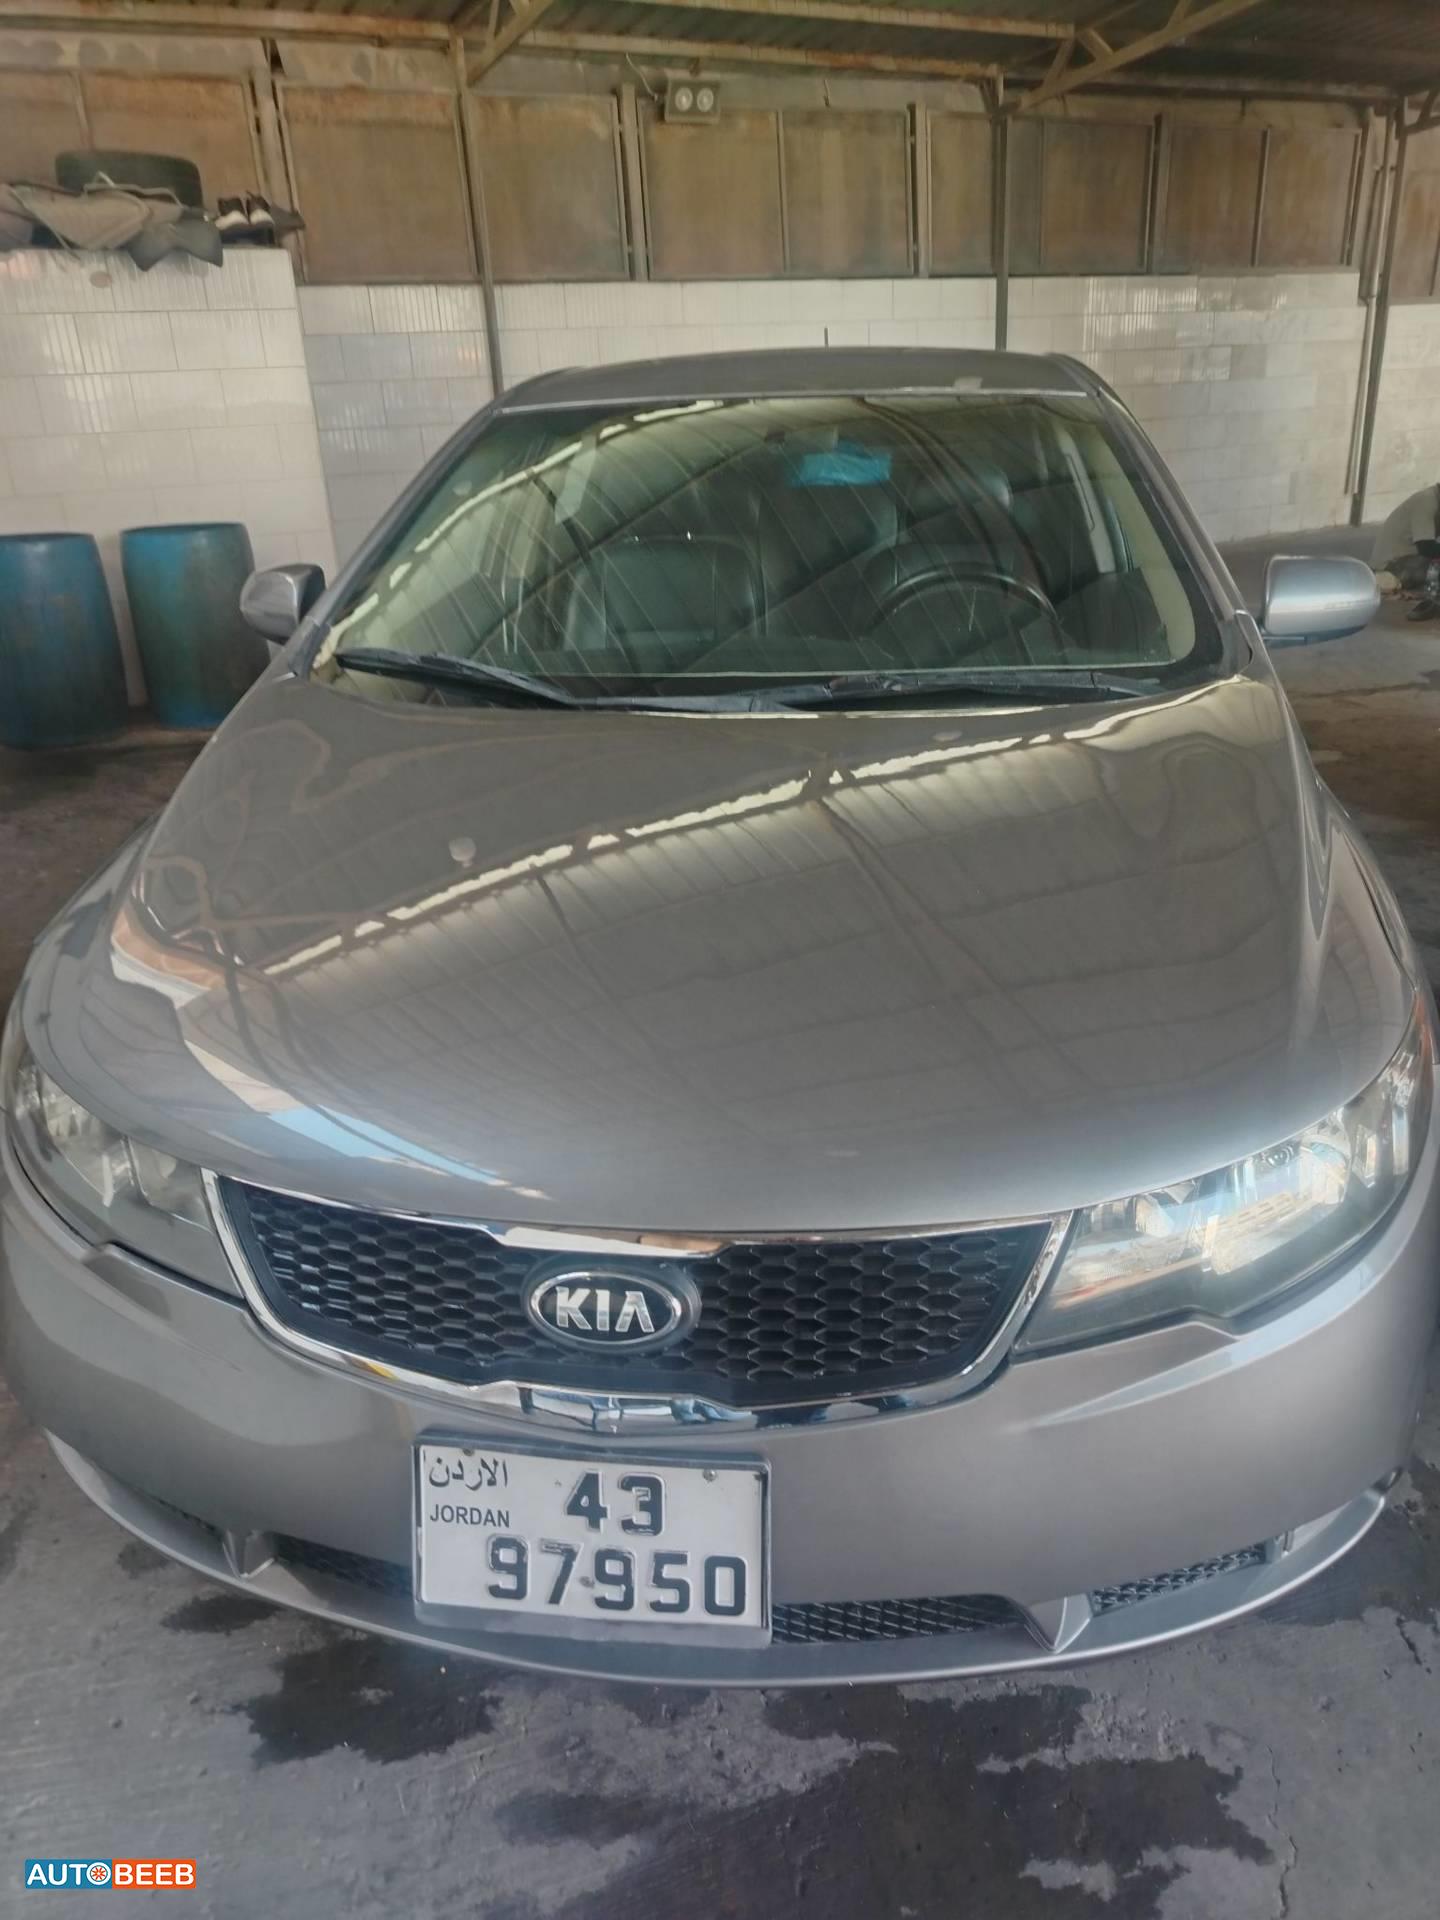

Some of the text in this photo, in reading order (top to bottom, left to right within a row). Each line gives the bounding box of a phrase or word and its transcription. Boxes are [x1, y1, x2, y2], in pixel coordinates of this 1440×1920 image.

[555, 1286, 655, 1333] KIA
[429, 1504, 511, 1528] JORDAN
[565, 1470, 666, 1536] 43
[487, 1534, 747, 1616] 97950
